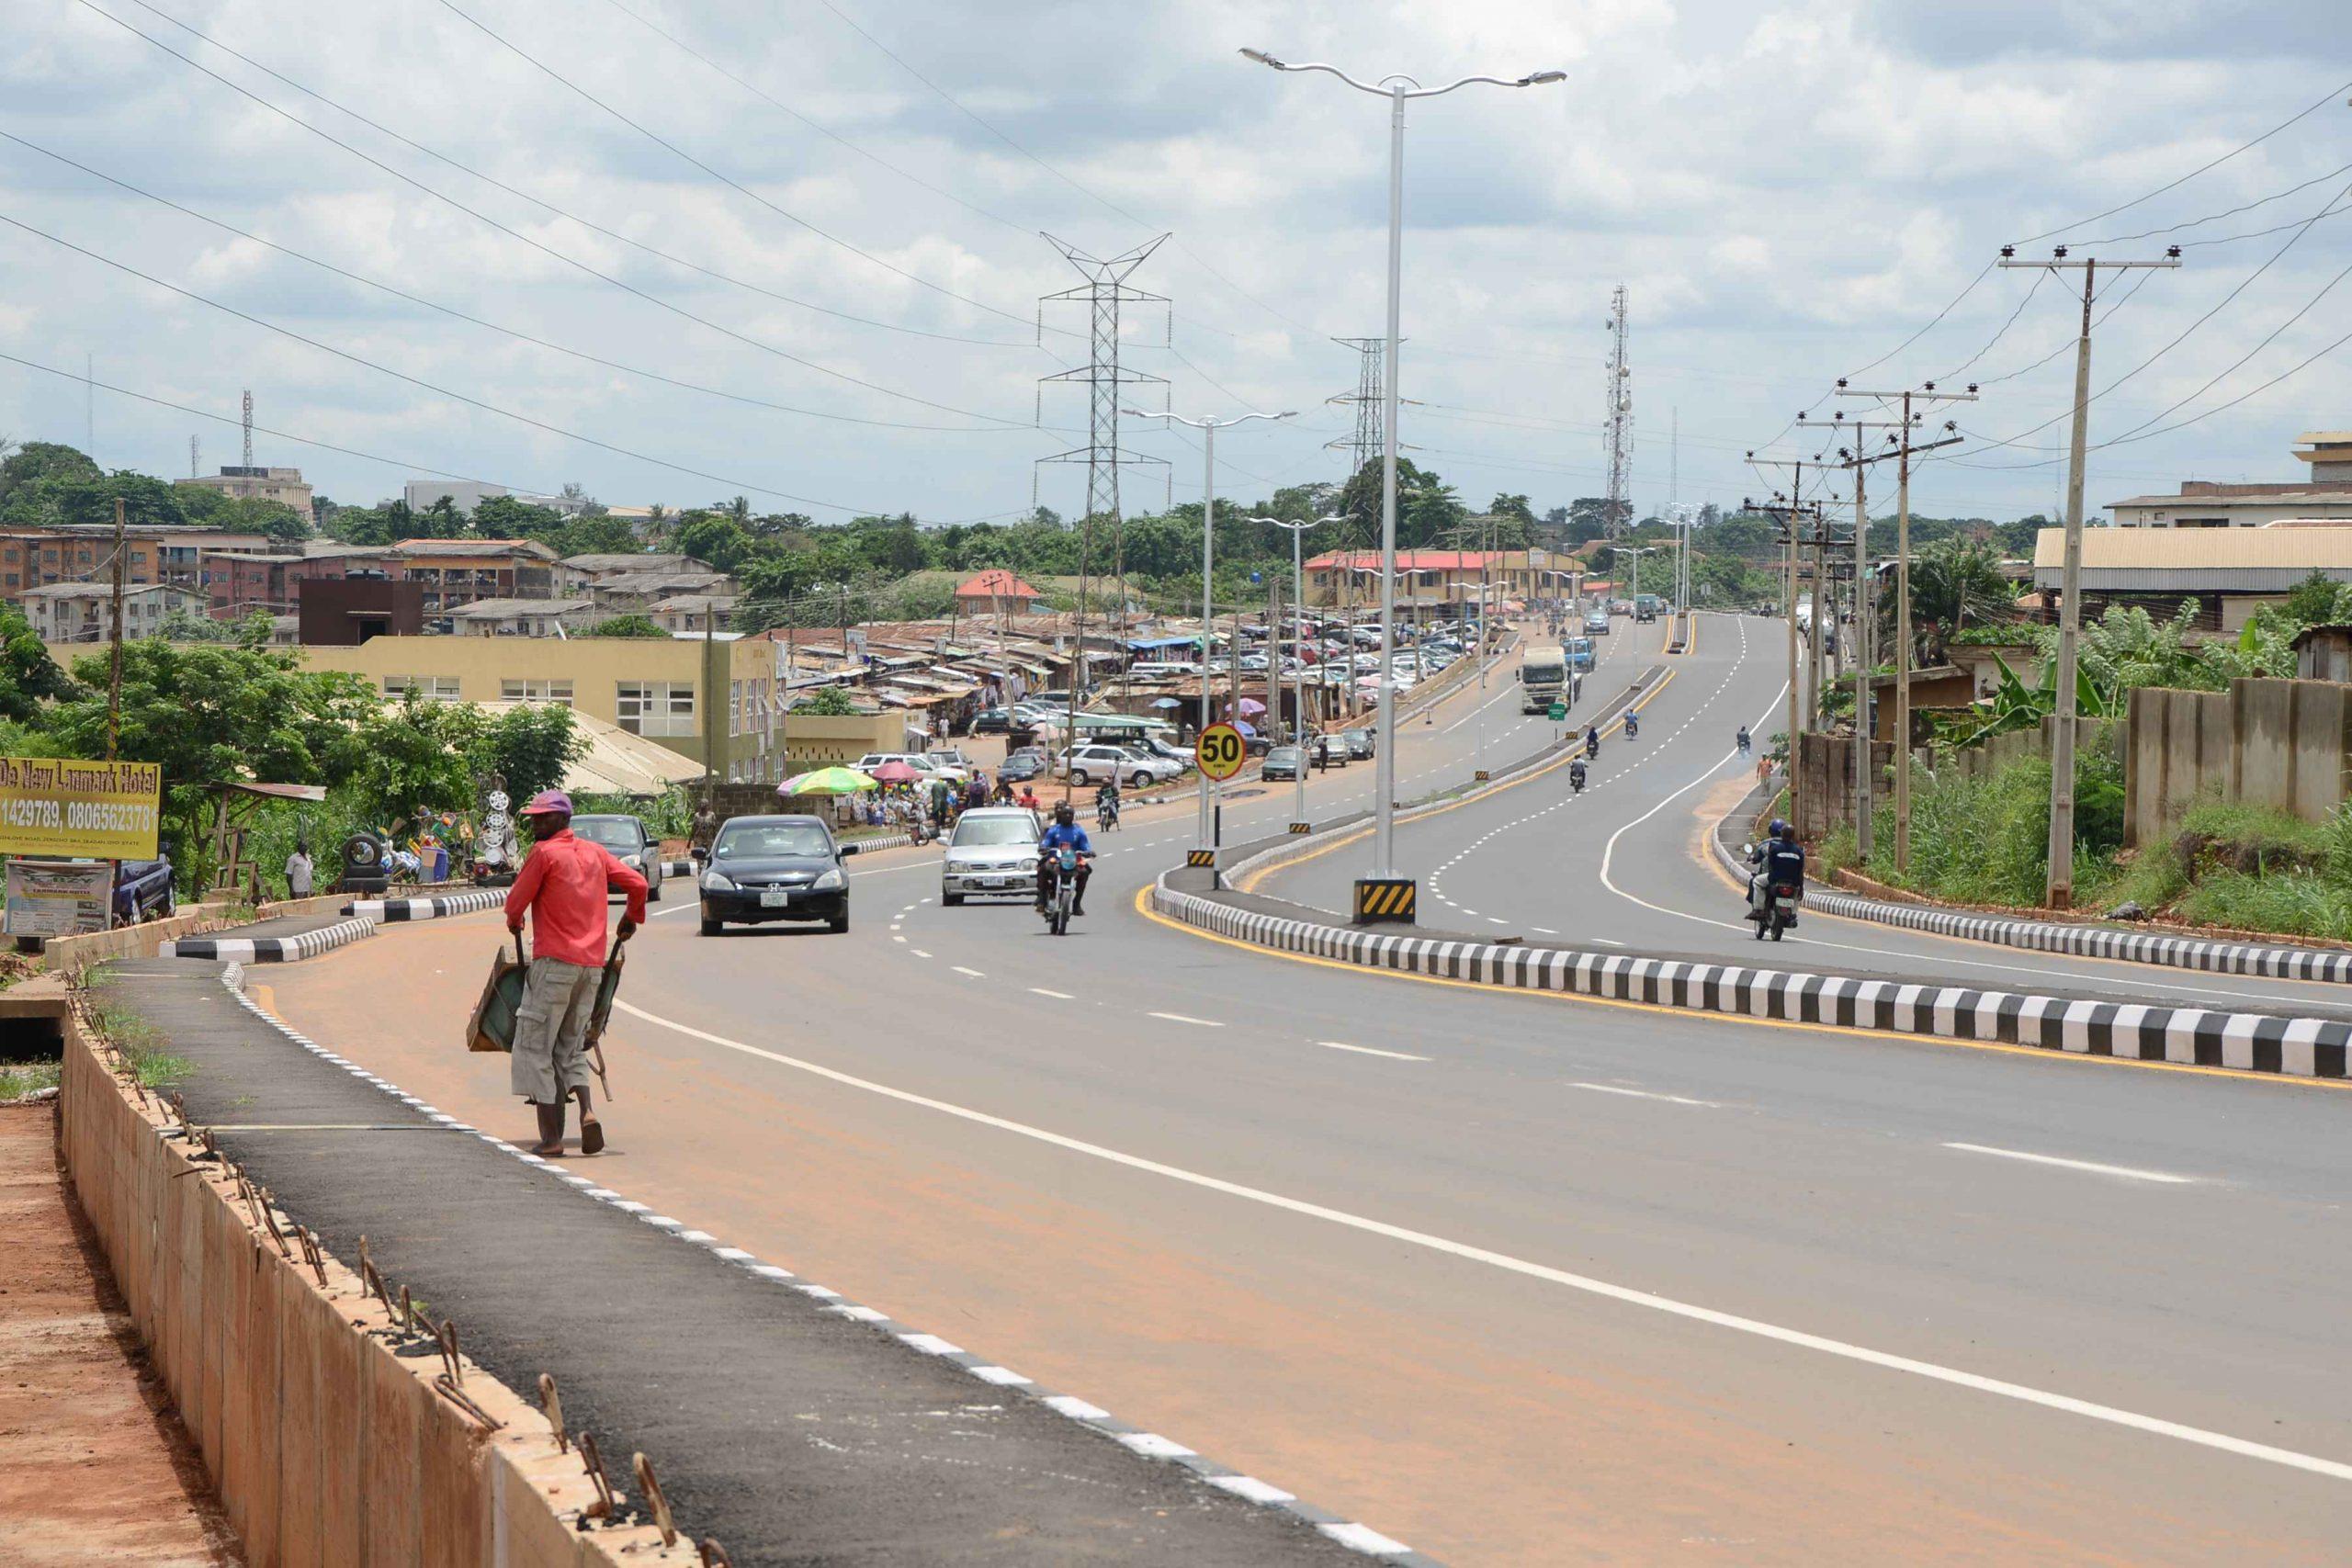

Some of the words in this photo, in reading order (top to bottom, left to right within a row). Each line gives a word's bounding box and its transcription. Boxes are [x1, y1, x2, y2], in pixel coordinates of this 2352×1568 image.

[1201, 734, 1239, 762] 50
[0, 758, 18, 788] De
[21, 760, 54, 791] New
[57, 761, 118, 794] Lanmark
[120, 764, 157, 796] Hotel
[68, 801, 158, 833] 08065623781
